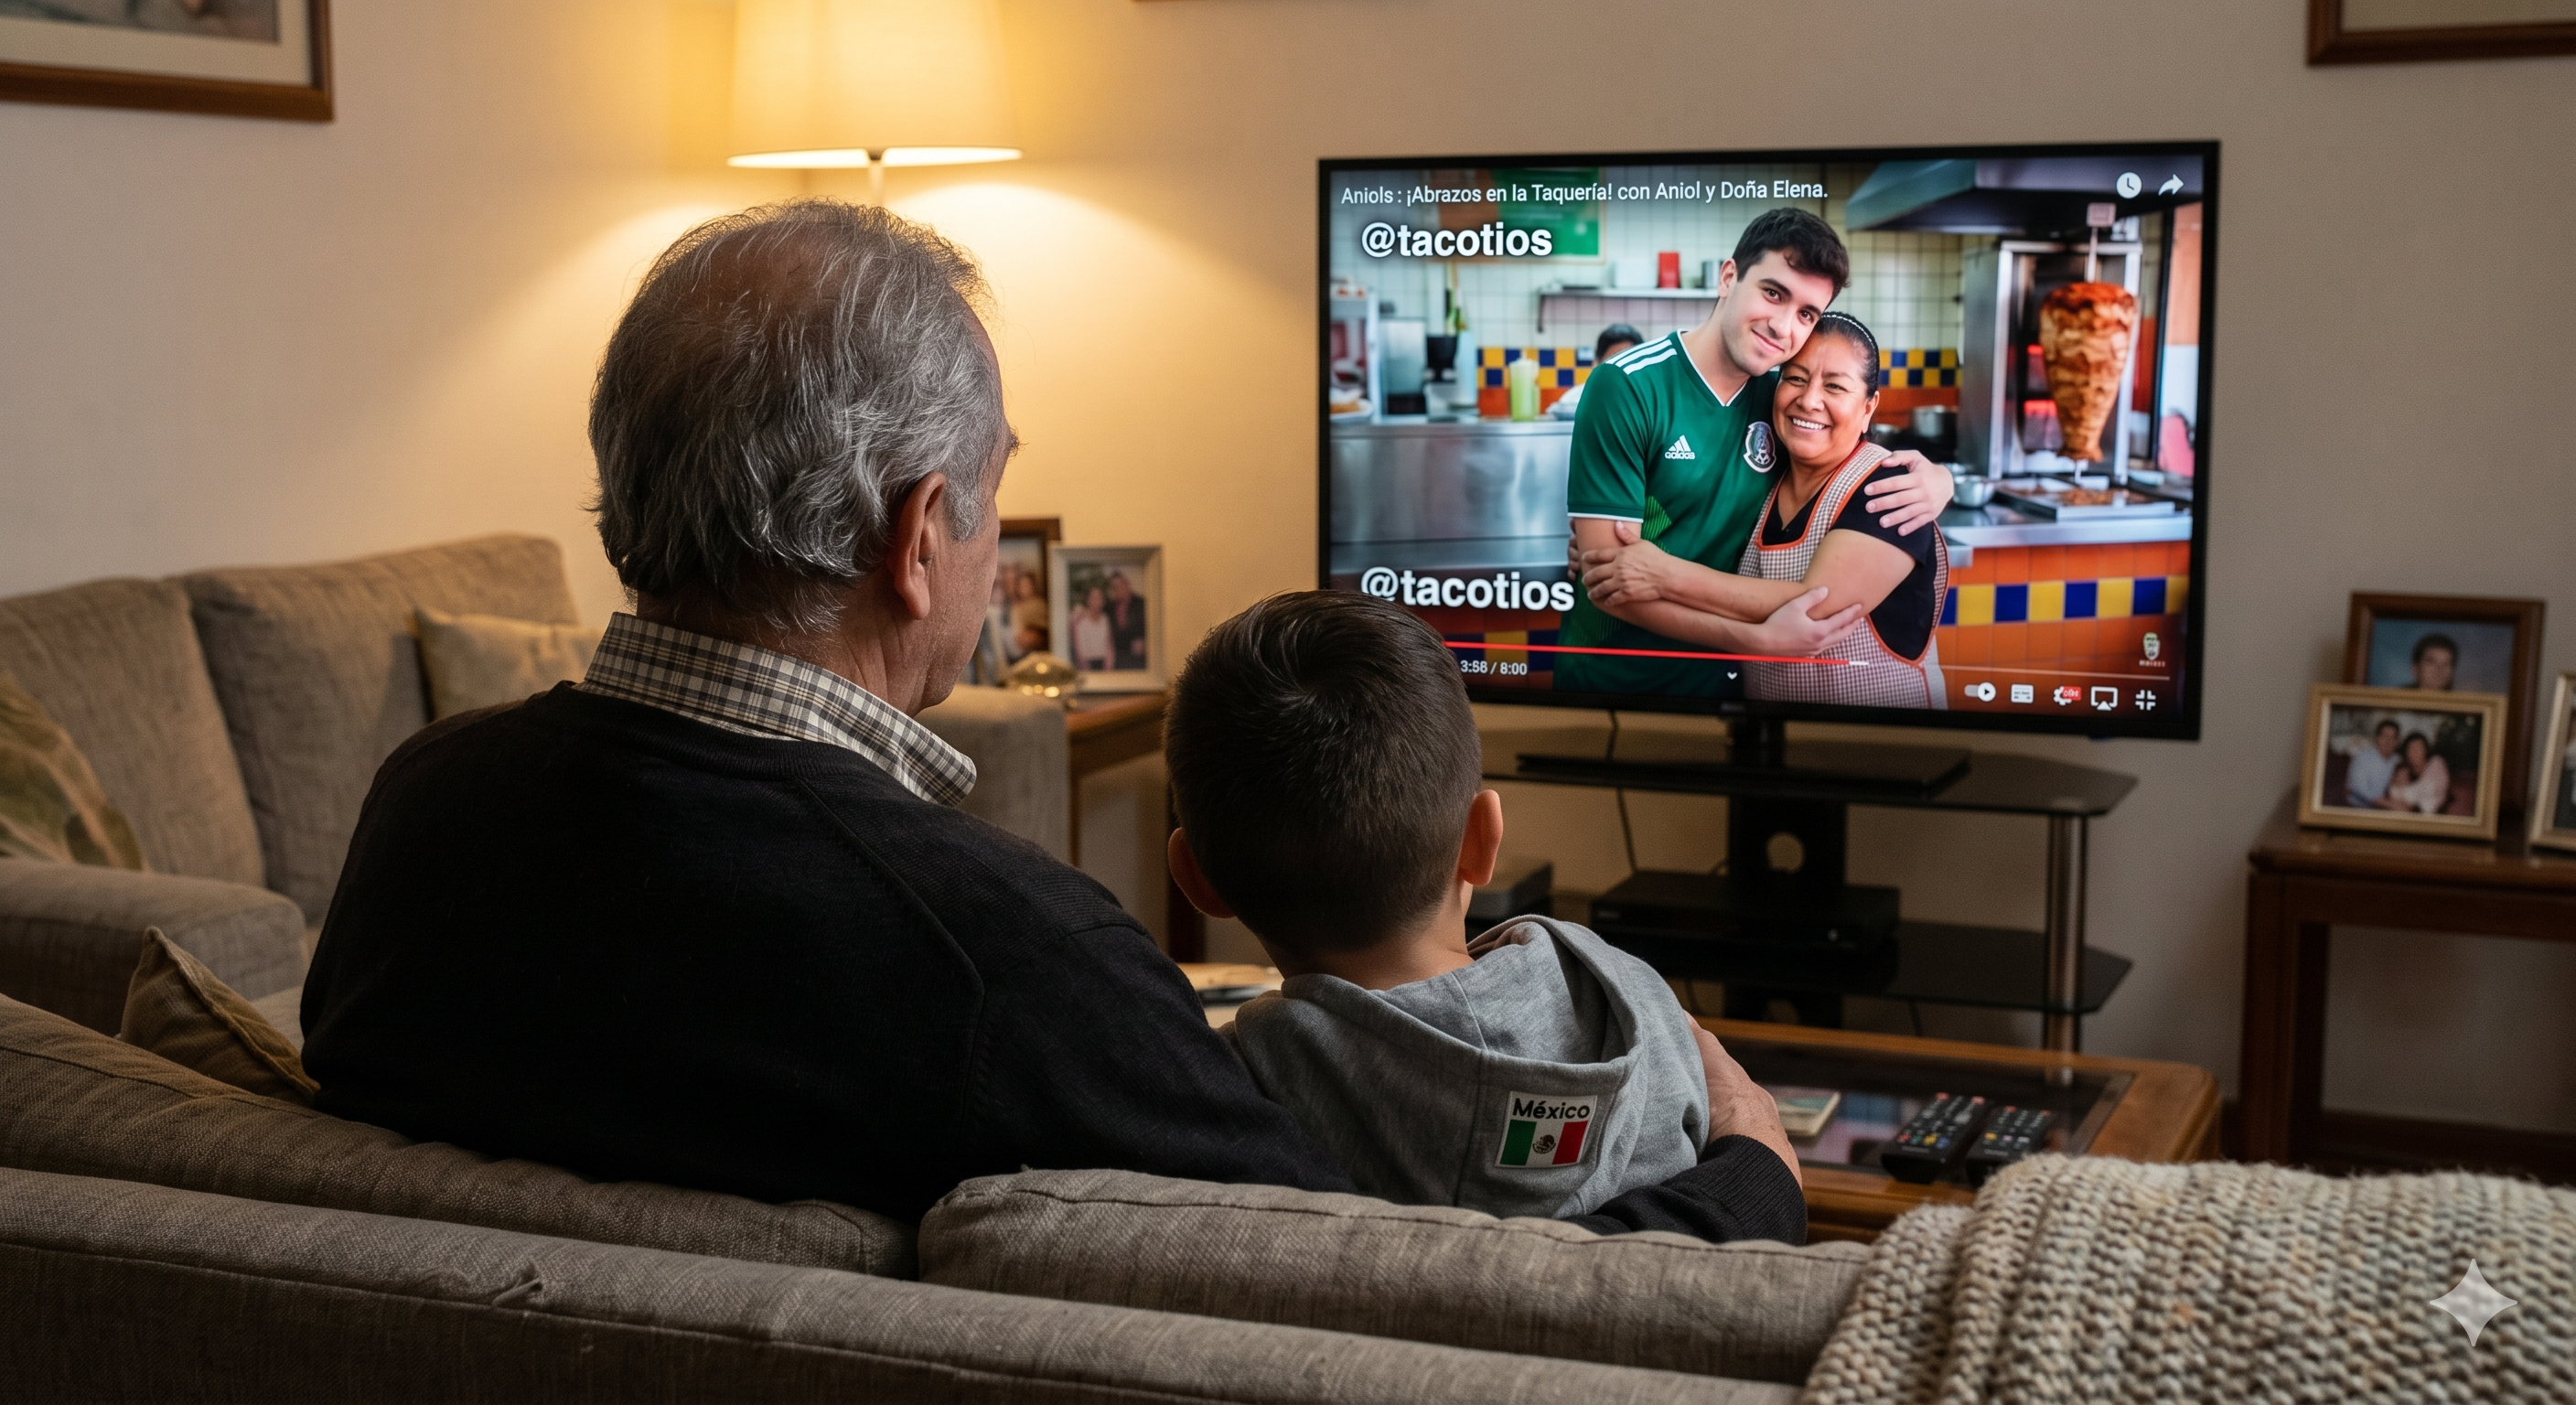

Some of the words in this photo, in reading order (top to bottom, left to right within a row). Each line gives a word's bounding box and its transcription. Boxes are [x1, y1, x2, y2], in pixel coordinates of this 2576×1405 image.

[1341, 186, 1393, 204] Aniols
[1407, 185, 1482, 207] ¡Abrazos
[1486, 188, 1507, 202] en
[1512, 184, 1528, 201] la
[1531, 183, 1612, 205] Taquería!
[1617, 186, 1650, 200] con
[1655, 180, 1701, 199] Aniol
[1705, 185, 1716, 203] y
[1721, 180, 1767, 198] Doña
[1773, 179, 1829, 198] Elena.
[1361, 221, 1553, 258] @tacotios
[1360, 566, 1575, 612] @tacotios
[1500, 661, 1528, 676] 8:00
[1512, 1098, 1590, 1120] México
